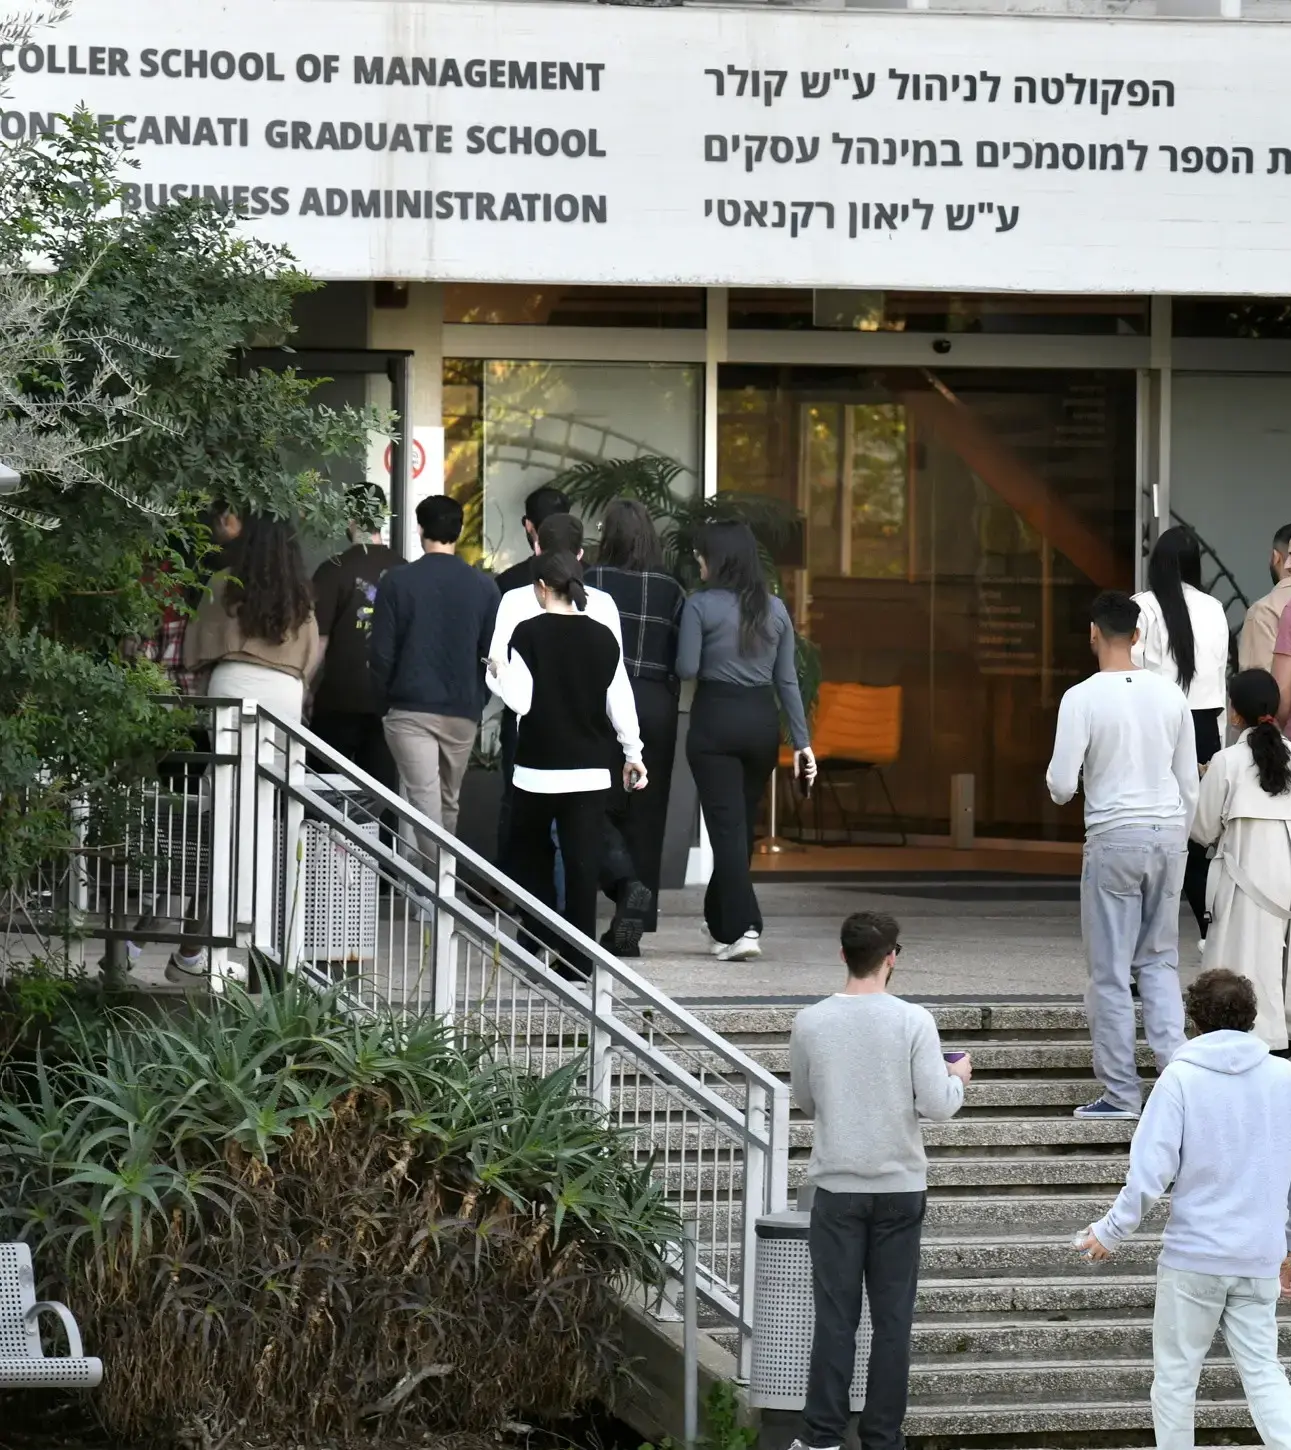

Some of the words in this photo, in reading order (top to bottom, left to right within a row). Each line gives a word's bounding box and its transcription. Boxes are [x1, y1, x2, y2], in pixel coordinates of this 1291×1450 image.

[0, 43, 131, 77] COLLER
[140, 48, 285, 82] SCHOOL
[296, 53, 340, 84] OF
[354, 56, 606, 92] MANAGEMENT
[704, 64, 788, 107] קולר
[800, 68, 876, 100] ע"ש
[888, 68, 1001, 103] לניהול
[1014, 72, 1175, 115] הפקולטה
[73, 112, 248, 147] ECANATI
[264, 120, 453, 154] GRADUATE
[466, 125, 607, 158] SCHOOL
[704, 134, 820, 173] עסקים
[832, 132, 963, 168] במינהל
[976, 139, 1149, 172] למוסמכים
[1159, 145, 1254, 174] הספר
[120, 182, 290, 216] BUSINESS
[299, 187, 607, 224] ADMINISTRATION
[704, 198, 835, 238] רקנאטי
[848, 198, 934, 239] ליאון
[945, 202, 1020, 233] ע"ש
